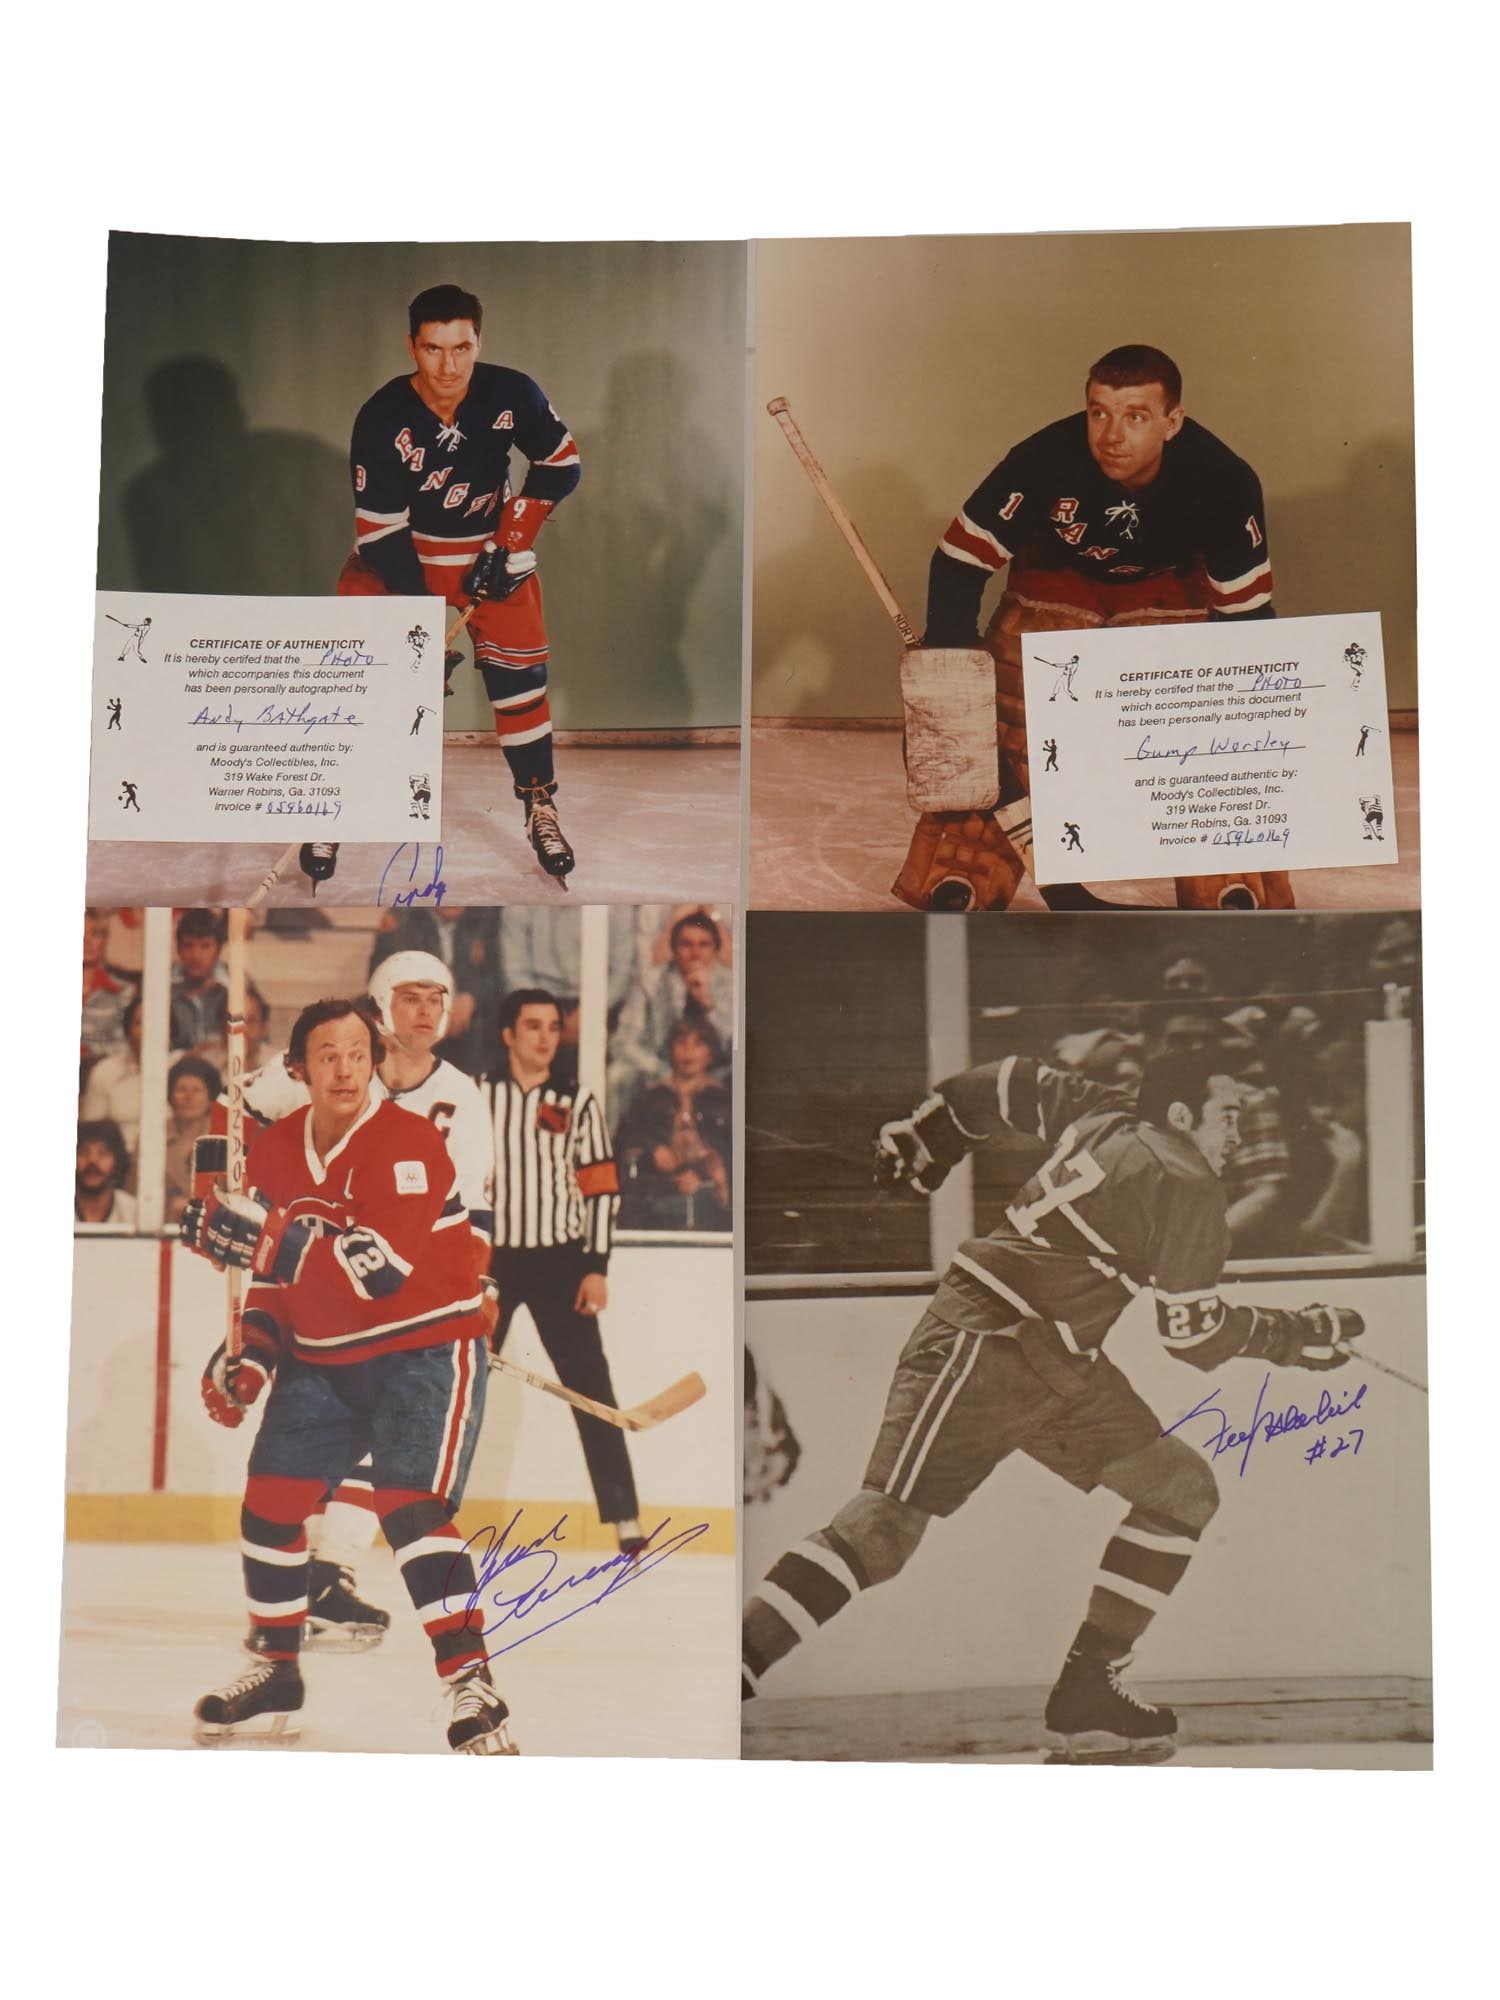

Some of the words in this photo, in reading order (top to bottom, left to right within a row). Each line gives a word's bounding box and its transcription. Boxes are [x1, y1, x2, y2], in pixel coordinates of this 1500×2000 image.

[491, 410, 514, 430] A
[513, 498, 527, 519] 9
[998, 492, 1024, 520] 1
[1244, 515, 1262, 549] 1
[190, 639, 263, 650] CERTIFICATE
[266, 639, 282, 650] OF
[283, 639, 366, 650] AUTHENTICITY
[164, 653, 172, 663] It
[173, 653, 182, 663] is
[185, 653, 220, 666] hereby
[222, 654, 262, 664] certifed
[264, 654, 282, 665] that
[284, 654, 300, 665] the
[189, 668, 219, 678] which
[222, 669, 290, 681] accompanies
[293, 669, 310, 679] this
[313, 669, 365, 679] document
[1120, 669, 1193, 682] CERTIFICATE
[1197, 667, 1213, 678] OF
[1215, 662, 1299, 677] AUTHENTICITY
[184, 684, 202, 693] has
[205, 684, 231, 693] been
[233, 684, 286, 696] personally
[288, 684, 353, 695] autographed
[355, 684, 368, 694] by
[1095, 689, 1102, 699] It
[1104, 689, 1113, 698] is
[1116, 687, 1152, 698] hereby
[1154, 684, 1193, 695] certifed
[1196, 683, 1217, 693] that
[1218, 682, 1234, 692] the
[1121, 702, 1152, 712] which
[1155, 698, 1224, 710] accompanies
[1228, 696, 1245, 706] this
[1249, 692, 1301, 705] document
[1118, 718, 1136, 727] has
[1139, 717, 1165, 726] been
[1168, 713, 1222, 727] personally
[1225, 708, 1291, 722] autographed
[1294, 707, 1308, 718] by
[196, 743, 216, 752] and
[218, 743, 226, 752] is
[230, 743, 287, 754] guaranteed
[290, 743, 335, 752] authentic
[338, 743, 354, 754] by:
[1210, 730, 1291, 758] Worsley
[210, 757, 252, 769] Moody's
[256, 757, 317, 768] Collectibles,
[320, 757, 339, 767] Inc.
[224, 772, 243, 782] 319
[246, 772, 273, 782] Wake
[275, 772, 307, 782] Forest
[310, 772, 325, 782] Dr.
[1135, 777, 1155, 787] and
[1157, 776, 1166, 786] is
[1169, 772, 1228, 787] guaranteed
[1231, 770, 1279, 781] authentic
[1282, 769, 1298, 780] by:
[208, 787, 244, 797] Warner
[247, 787, 285, 798] Robins,
[288, 787, 305, 797] Ga.
[309, 787, 341, 797] 31093
[1151, 790, 1194, 802] Moody's
[1197, 786, 1261, 798] Collectibles,
[1264, 785, 1284, 794] Inc.
[215, 802, 251, 812] Invoice
[254, 802, 262, 811] #
[1166, 805, 1186, 815] 319
[1189, 803, 1216, 813] Wake
[1219, 801, 1252, 812] Forest
[1255, 800, 1271, 809] Dr.
[1152, 821, 1188, 831] Warner
[1191, 818, 1231, 829] Robins,
[1234, 816, 1251, 826] Ga.
[1255, 814, 1287, 825] 31093
[1160, 836, 1196, 846] Invoice
[1200, 834, 1208, 843] #
[232, 1055, 242, 1193] CANADI
[1167, 1297, 1219, 1337] 27
